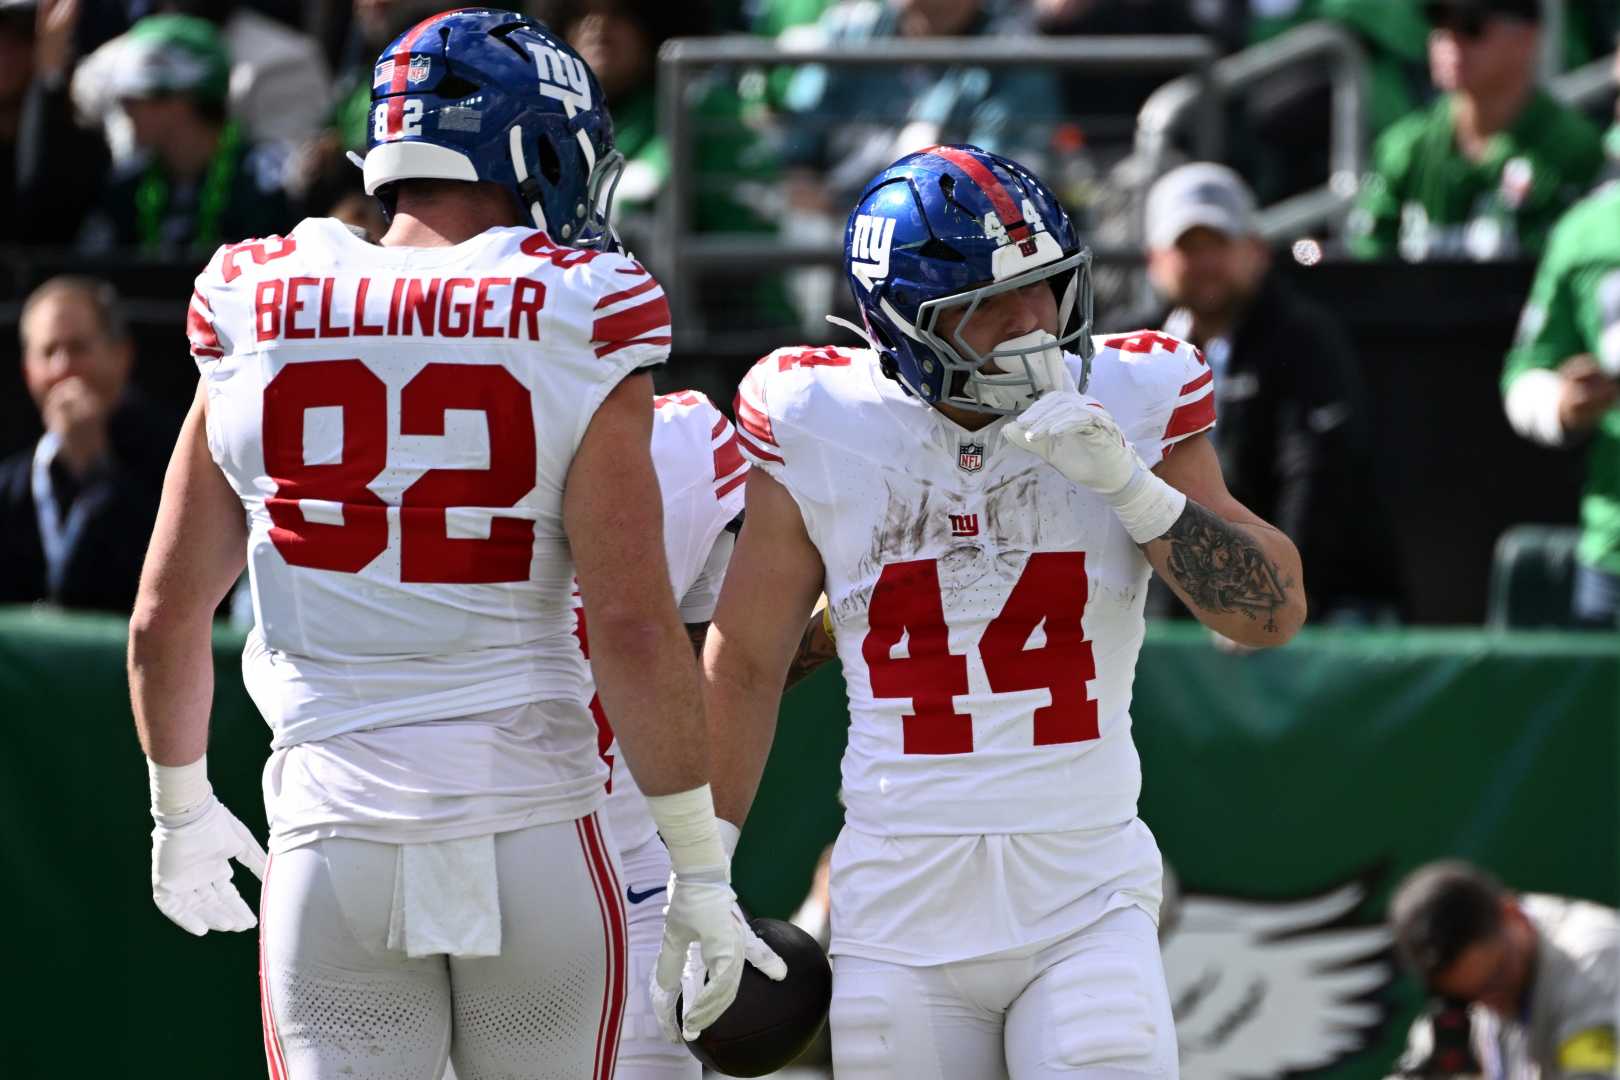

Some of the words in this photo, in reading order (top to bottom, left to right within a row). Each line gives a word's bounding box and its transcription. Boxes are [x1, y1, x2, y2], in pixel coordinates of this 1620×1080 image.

[374, 98, 423, 141] 82
[984, 199, 1046, 247] 44
[255, 277, 547, 341] BELLINGER
[262, 358, 537, 584] 82
[862, 551, 1101, 755] 44
